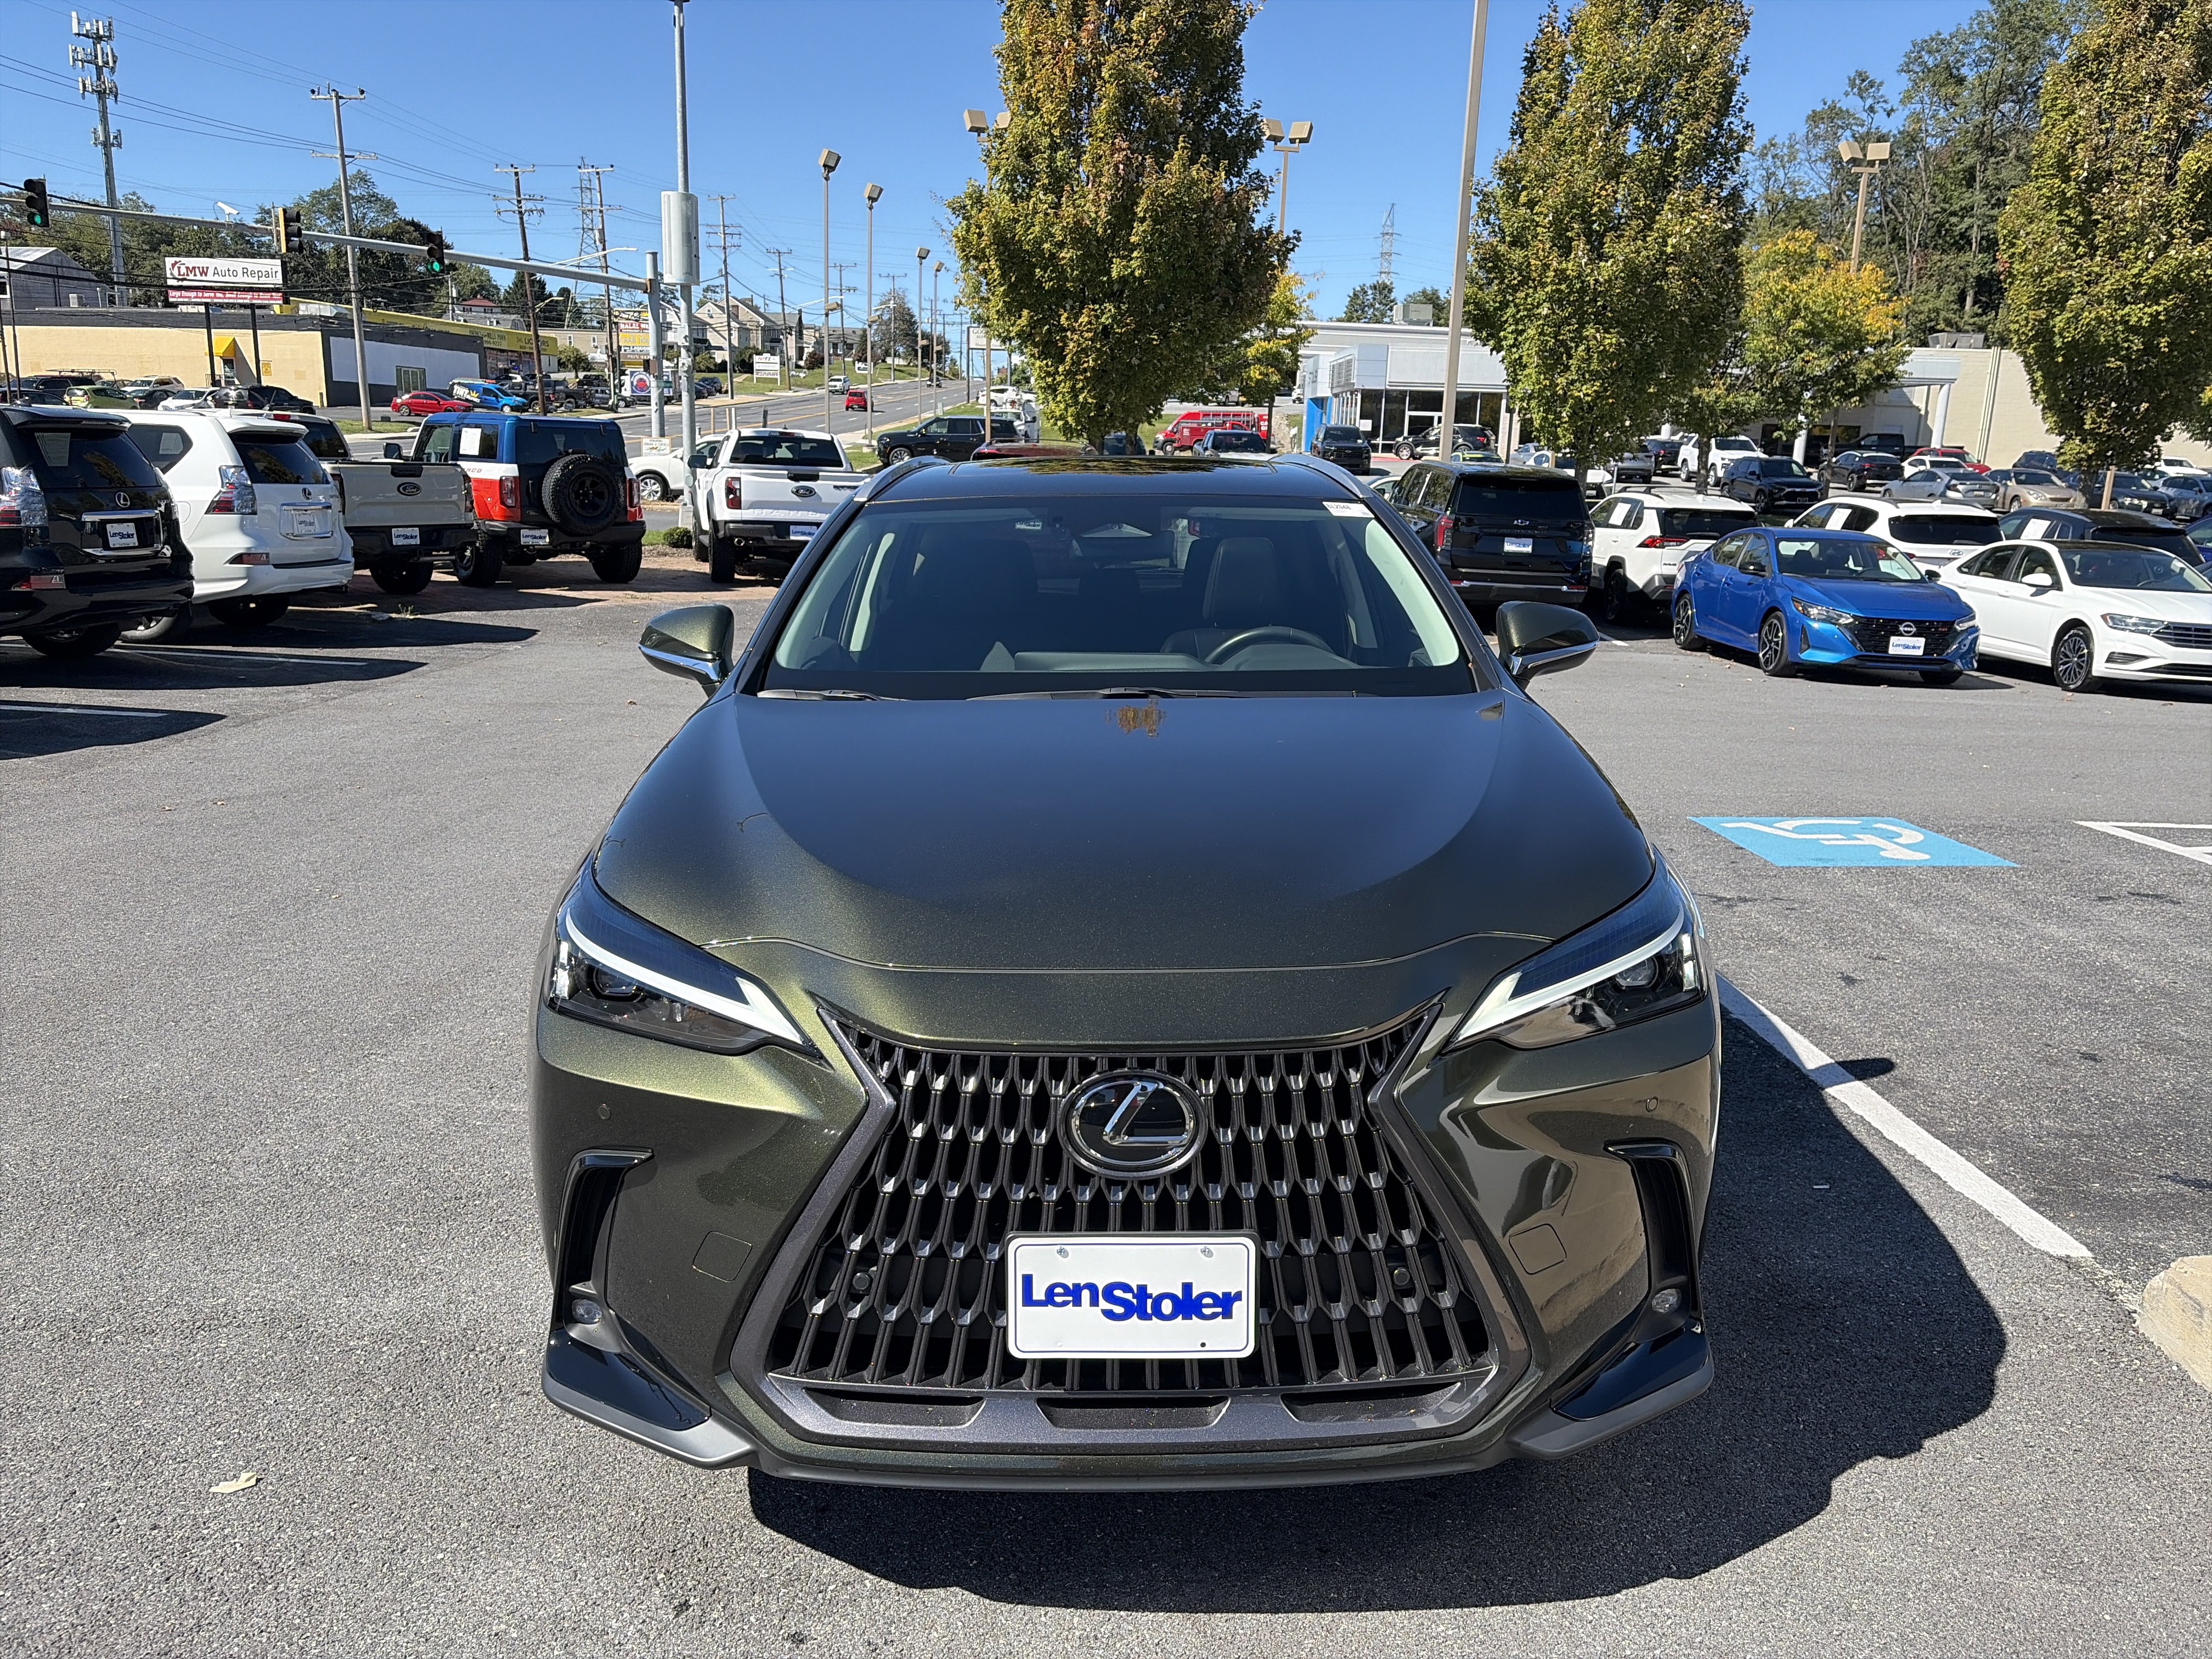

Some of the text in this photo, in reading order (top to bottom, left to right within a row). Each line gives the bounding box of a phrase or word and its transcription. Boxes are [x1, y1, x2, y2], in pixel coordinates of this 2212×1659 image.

[177, 266, 279, 281] LMW Auto Repair
